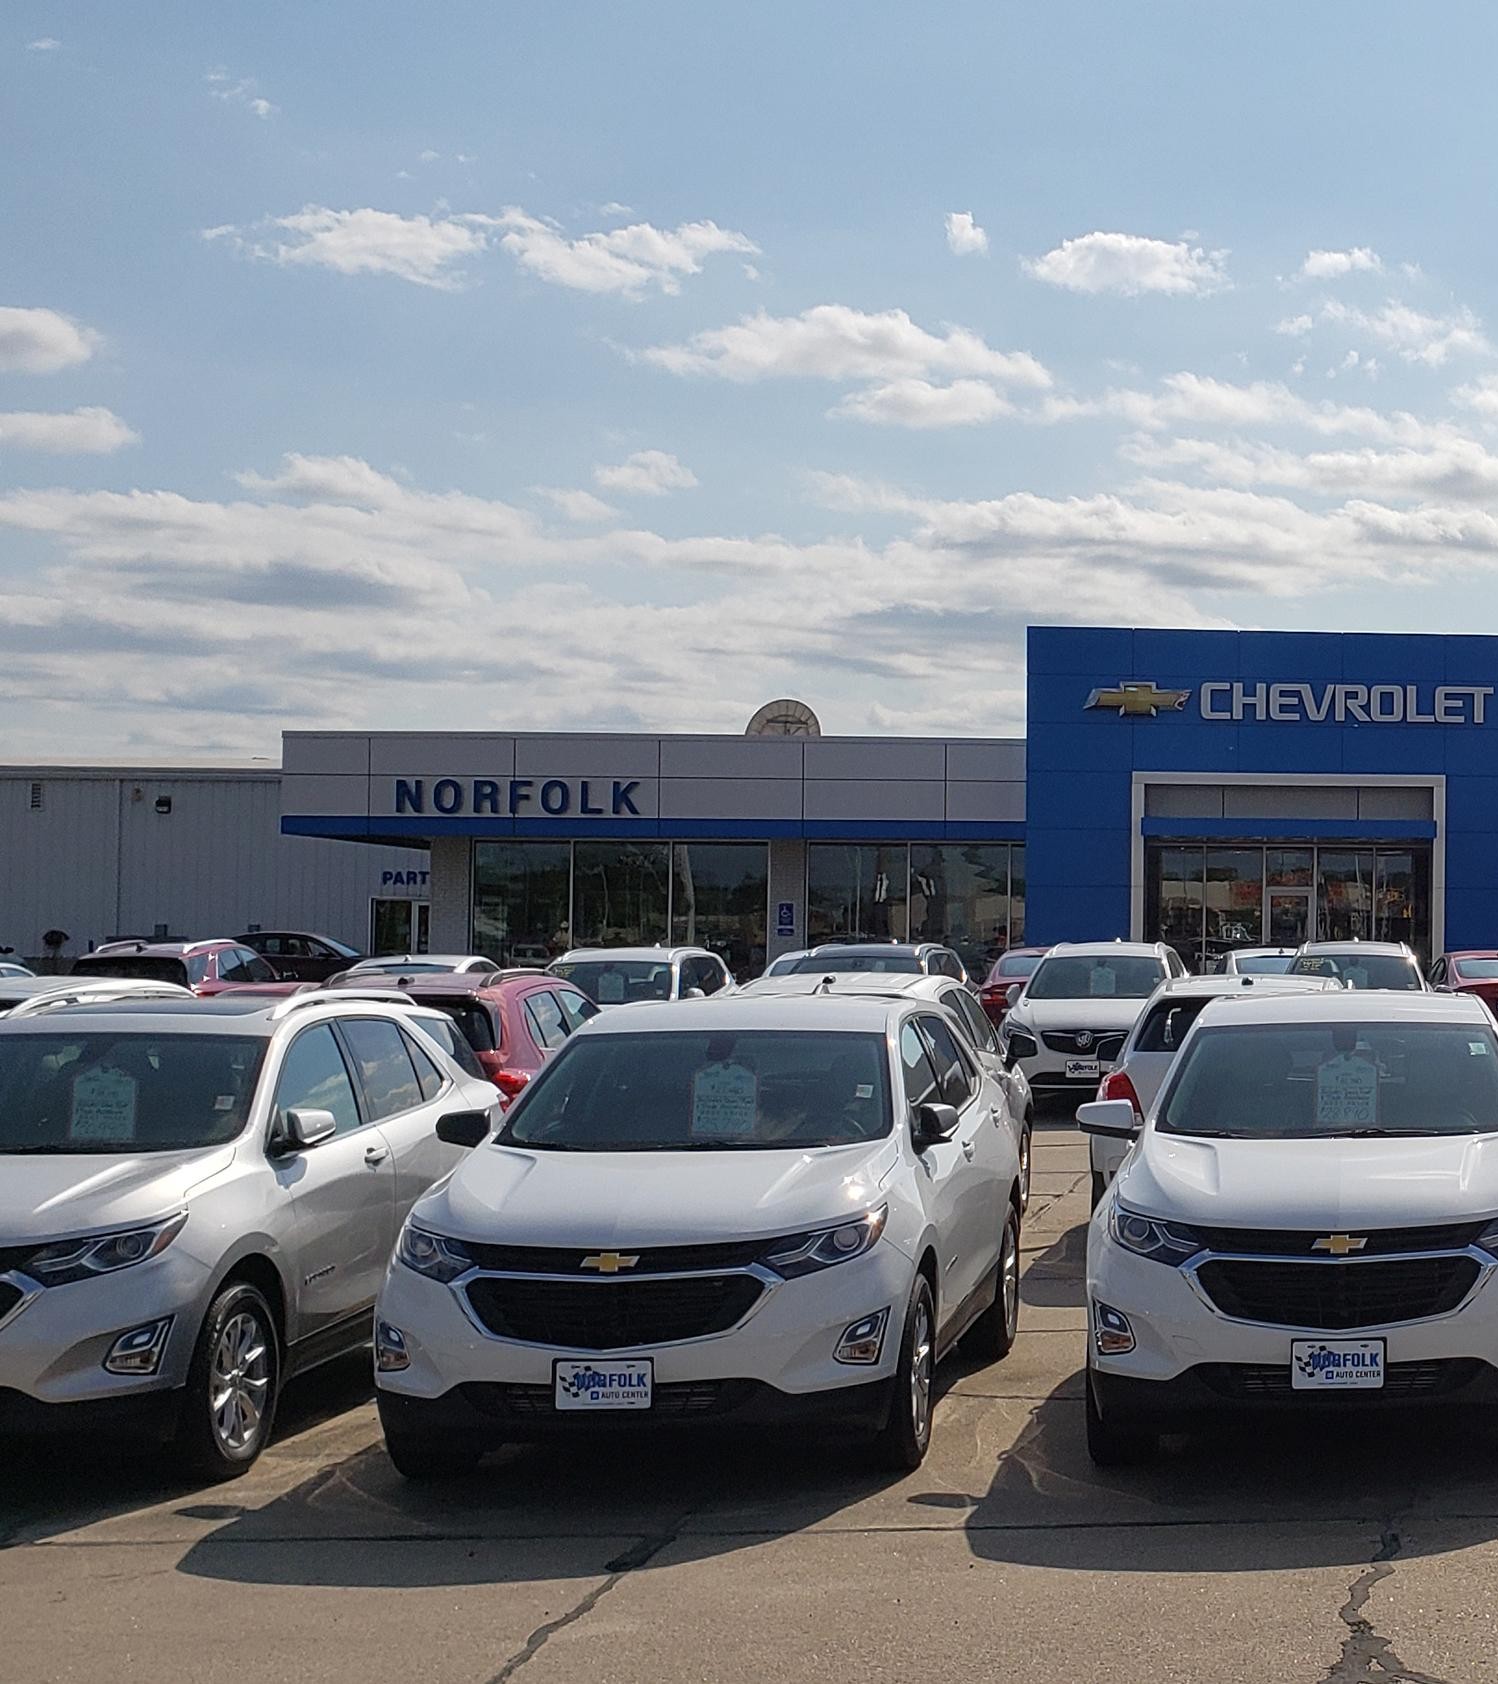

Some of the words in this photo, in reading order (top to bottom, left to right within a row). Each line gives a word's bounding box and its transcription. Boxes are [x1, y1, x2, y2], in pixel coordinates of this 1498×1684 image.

[1200, 681, 1495, 724] CHEVROLET
[395, 779, 640, 815] NORFOLK
[1311, 1352, 1379, 1368] NORFOLK
[574, 1372, 647, 1388] NORFOLK
[1335, 1370, 1354, 1379] AUTO
[1355, 1370, 1381, 1379] CENTER
[601, 1390, 620, 1400] AUTO
[621, 1390, 649, 1400] CENTER
